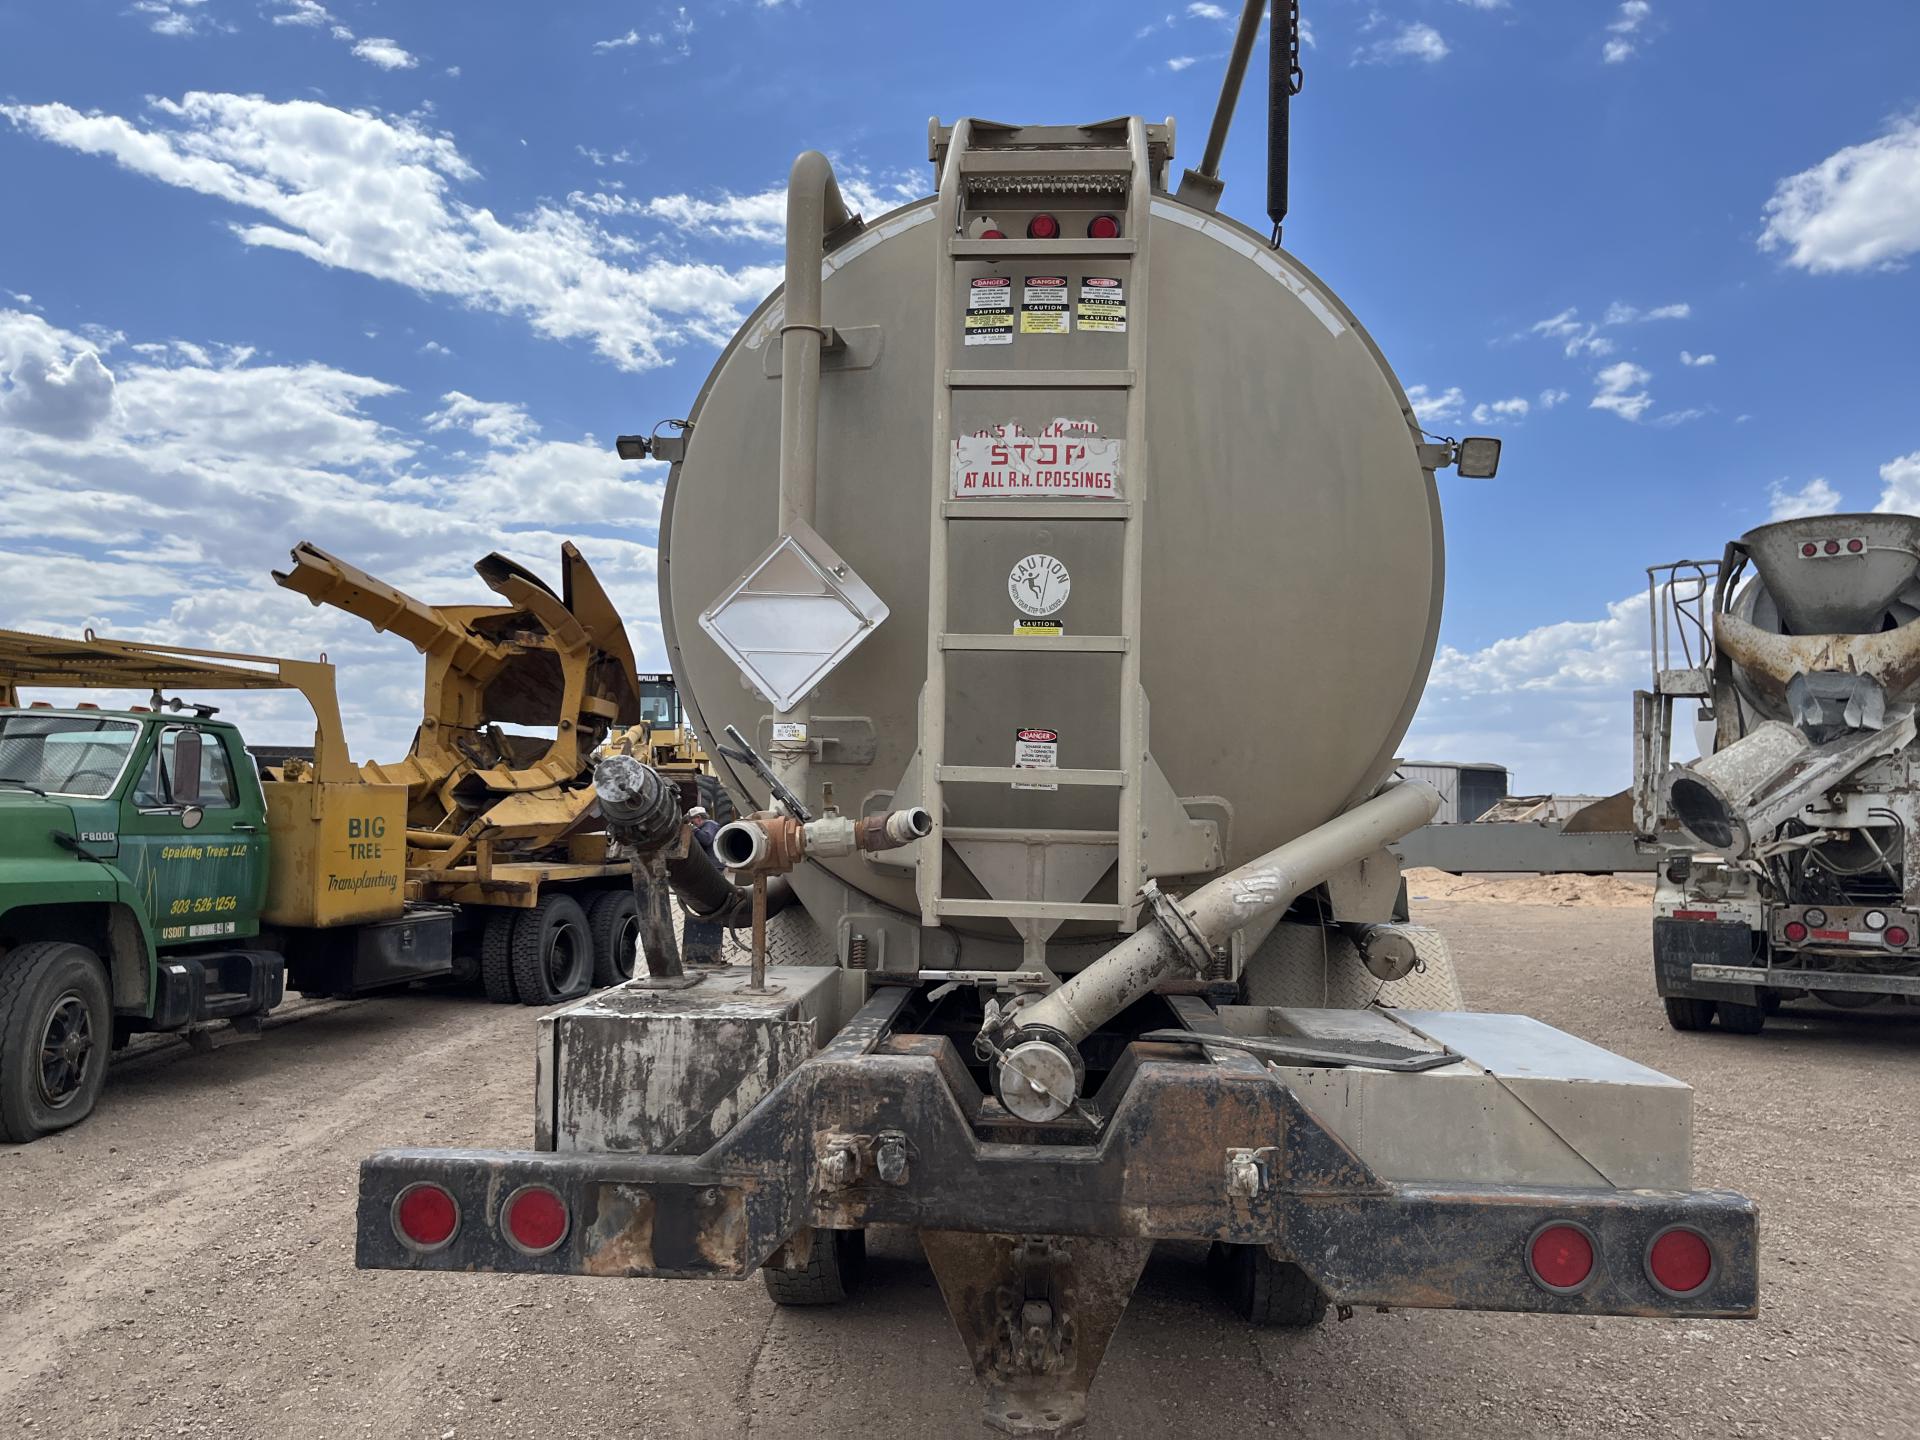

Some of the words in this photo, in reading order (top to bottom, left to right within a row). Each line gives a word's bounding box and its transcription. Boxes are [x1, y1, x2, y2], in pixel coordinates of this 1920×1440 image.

[991, 444, 1086, 466] STOP
[964, 472, 978, 488] AT
[982, 472, 1004, 488] ALL
[1036, 471, 1111, 488] CROSSINGS
[1011, 556, 1069, 584] CAUTION
[348, 816, 385, 839] BIG
[81, 832, 115, 841] F8000
[161, 845, 203, 860] Spalding
[206, 845, 230, 857] Trees
[231, 845, 248, 857] LLC
[348, 843, 382, 860] TREE
[328, 870, 398, 895] Transplanting
[162, 926, 187, 939] USDOT
